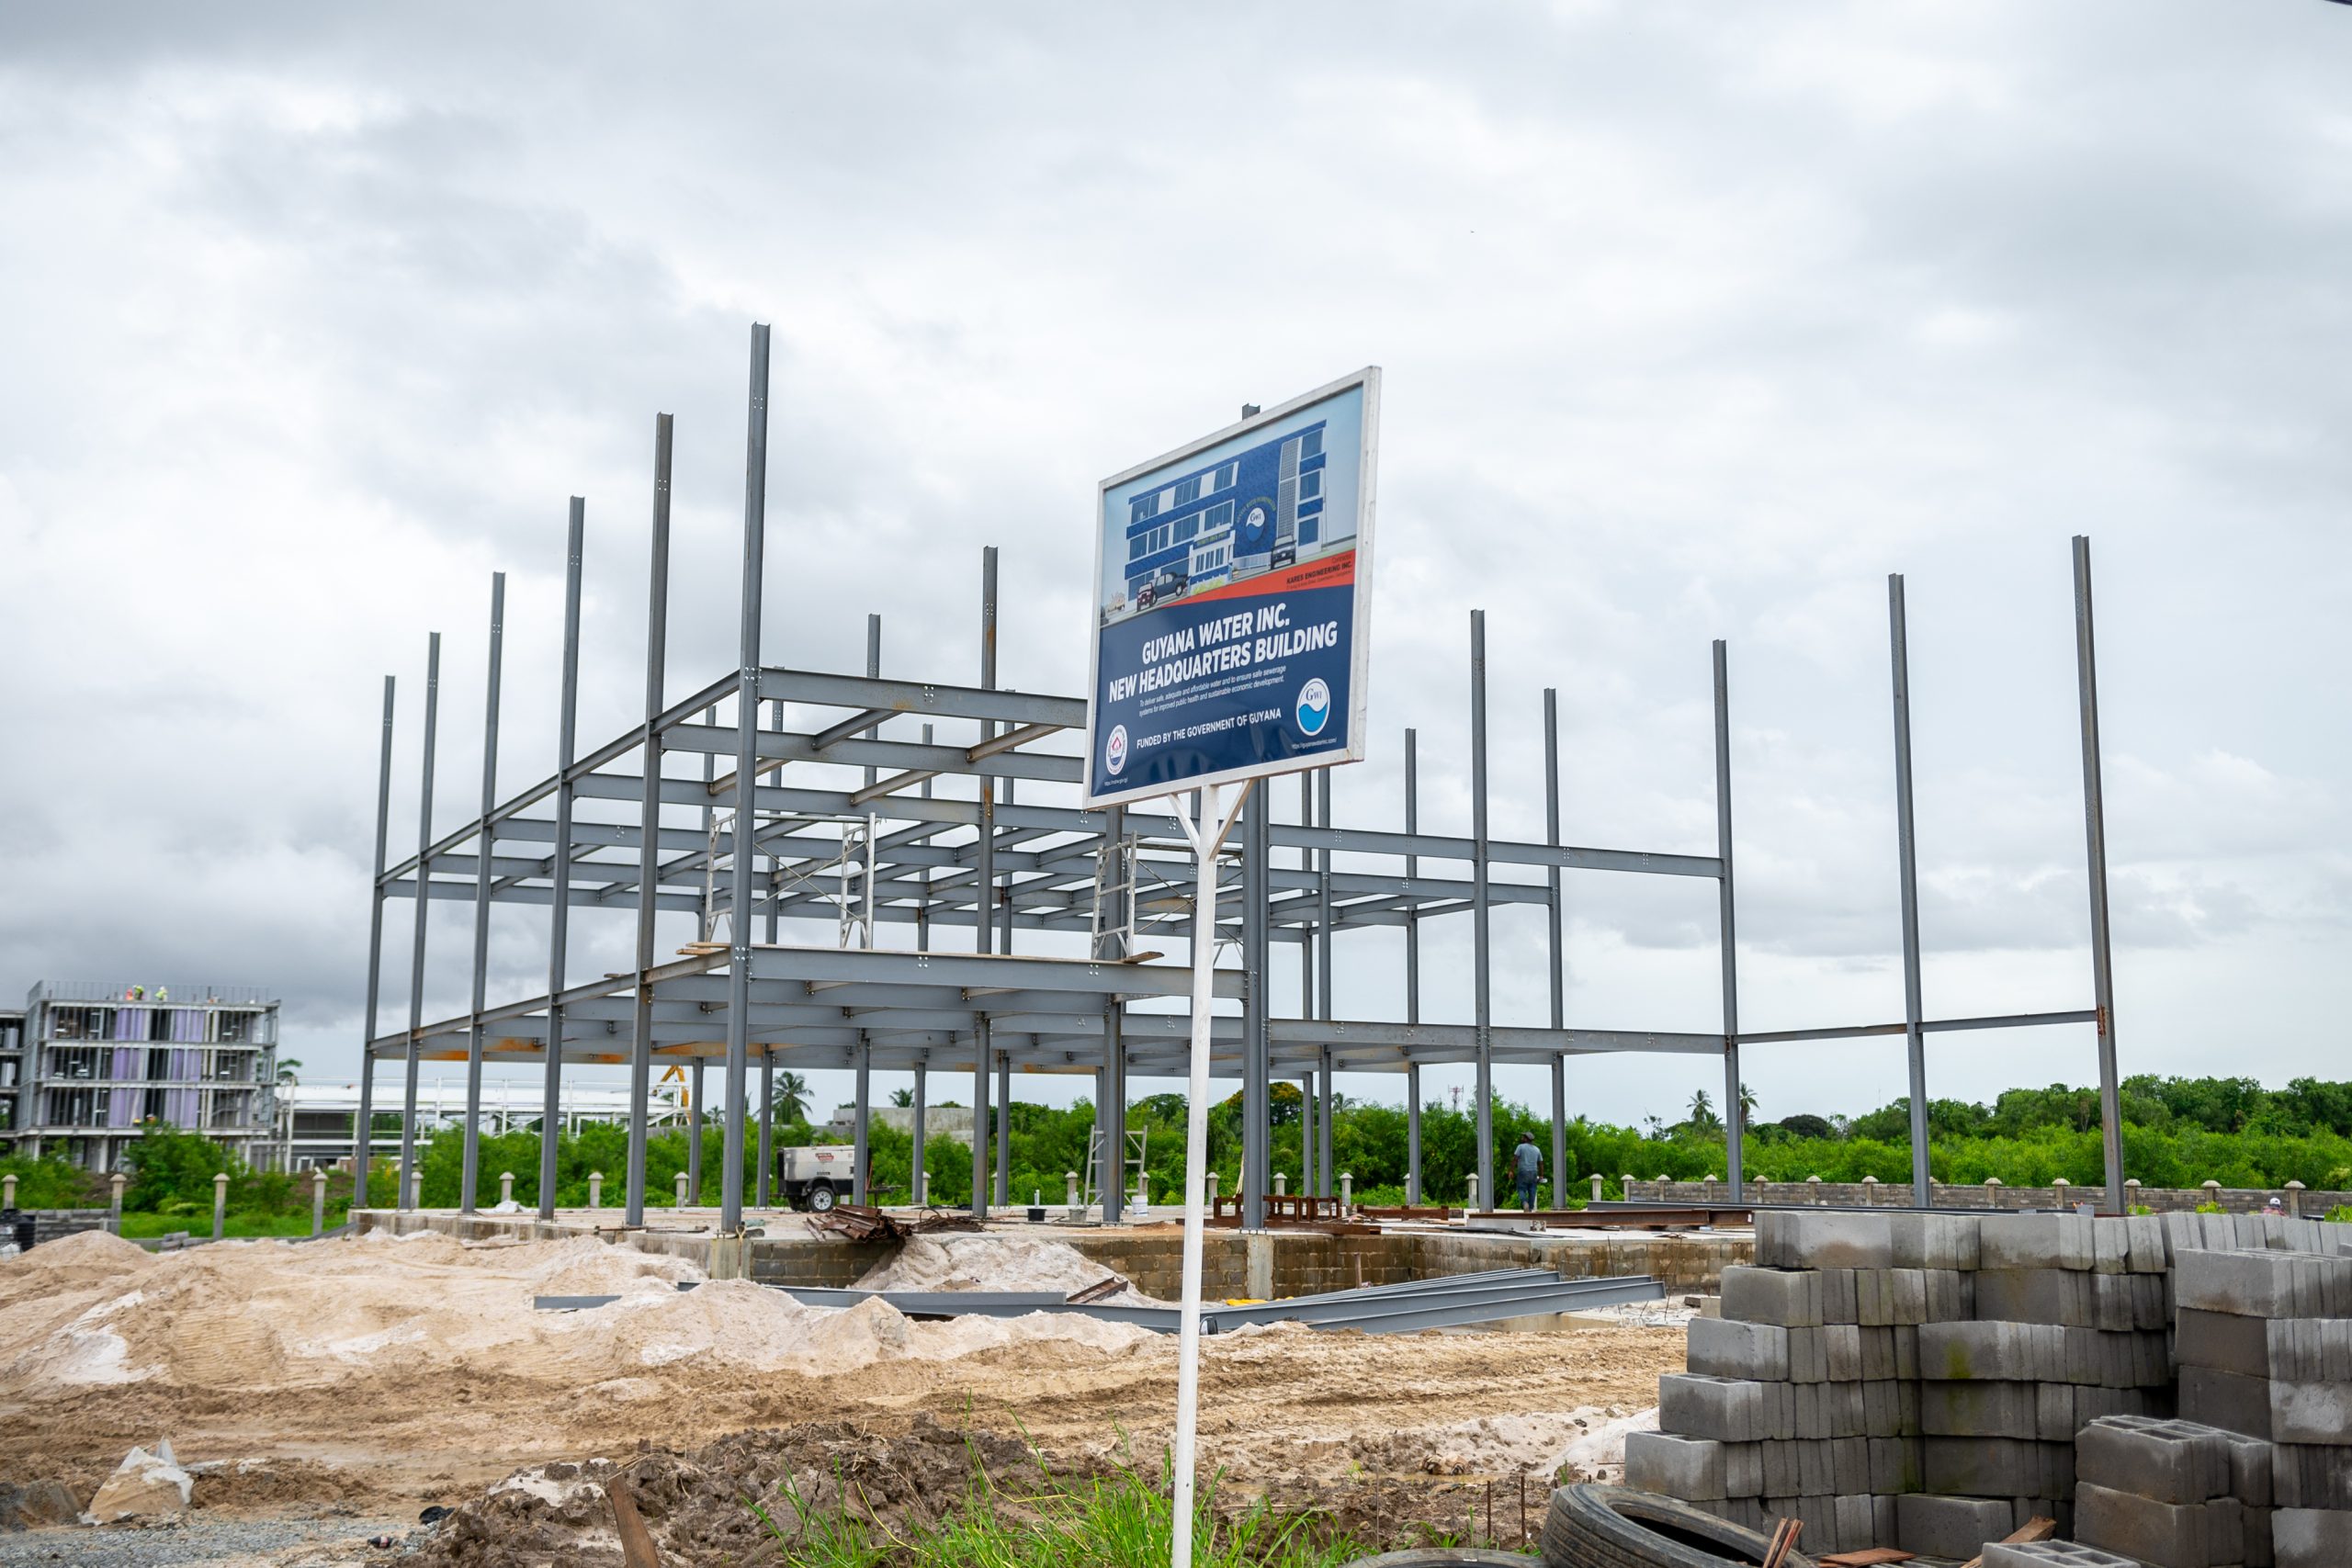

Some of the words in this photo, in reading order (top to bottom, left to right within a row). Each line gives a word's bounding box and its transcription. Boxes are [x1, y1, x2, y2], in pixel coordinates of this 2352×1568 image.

[1287, 573, 1305, 584] KARES
[1305, 564, 1340, 580] ENGINEERING
[1142, 627, 1194, 665] GUYANA
[1198, 611, 1252, 648] WATER
[1256, 603, 1290, 635] INC.
[1109, 673, 1138, 704] NEW
[1139, 641, 1251, 694] HEADQUARTERS
[1254, 620, 1338, 663] BUILDING
[1139, 707, 1154, 718] systems
[1159, 700, 1176, 713] improved
[1176, 697, 1187, 709] public
[1187, 694, 1199, 704] health
[1200, 692, 1208, 701] and
[1208, 687, 1231, 699] sustainable
[1231, 682, 1253, 693] economic
[1145, 697, 1156, 706] deliver
[1165, 690, 1182, 701] adequate
[1182, 687, 1191, 695] and
[1191, 682, 1210, 694] affordable
[1210, 680, 1221, 689] water
[1222, 677, 1230, 685] and
[1237, 672, 1251, 682] ensure
[1252, 669, 1262, 679] safe
[1263, 665, 1286, 676] sewerage
[1136, 735, 1161, 750] FUNDED
[1162, 733, 1171, 743] BY
[1172, 730, 1185, 741] THE
[1187, 717, 1235, 737] GOVERNMENT
[1237, 715, 1248, 727] OF
[1249, 707, 1282, 725] GUYANA
